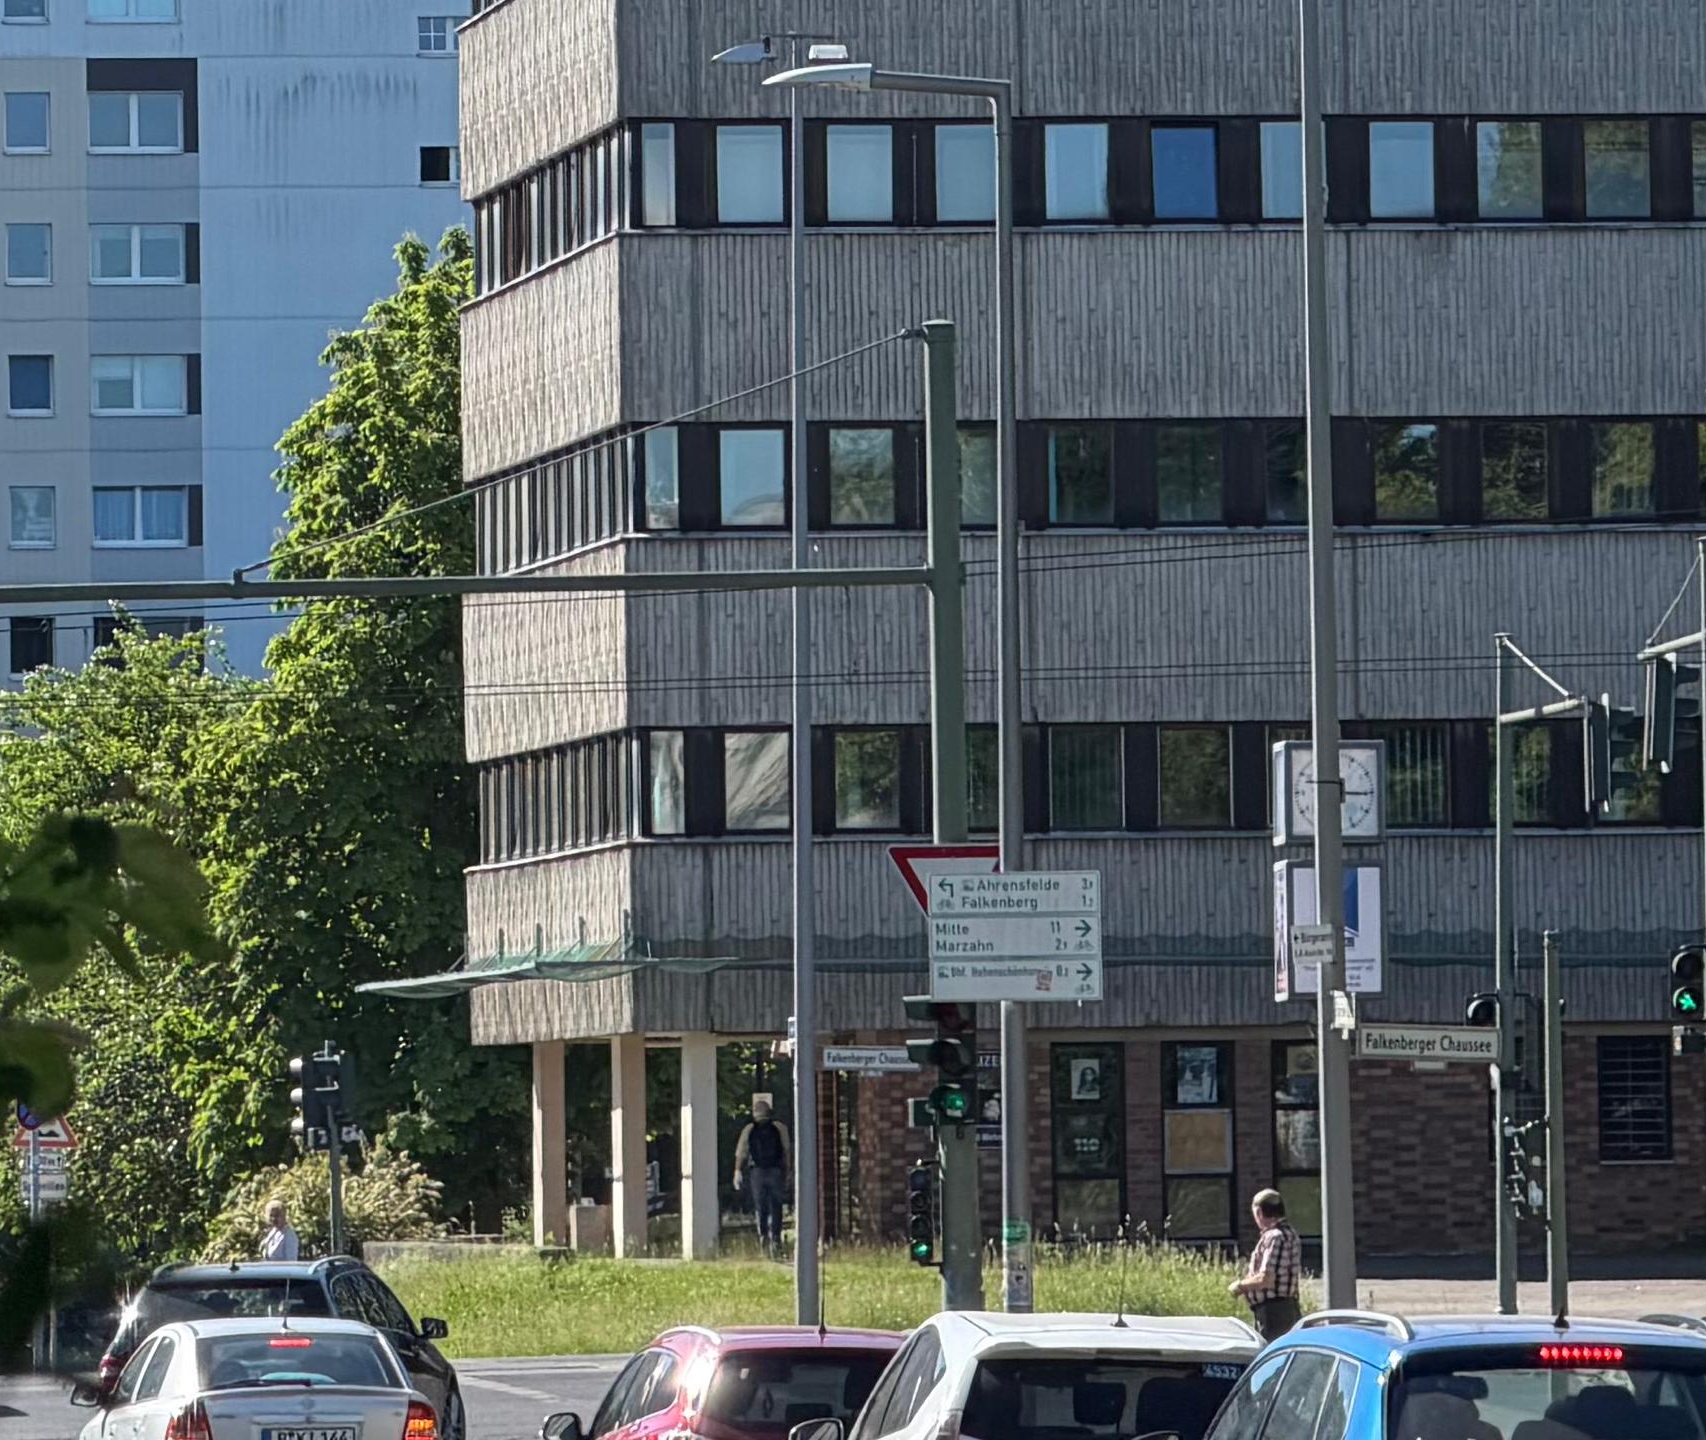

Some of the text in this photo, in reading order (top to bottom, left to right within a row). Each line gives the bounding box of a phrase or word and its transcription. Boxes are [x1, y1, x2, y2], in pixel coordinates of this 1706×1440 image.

[977, 879, 1060, 891] Ahrensfelde
[961, 895, 1038, 911] Falkenberg
[935, 920, 1061, 935] Mitte 11
[935, 939, 994, 952] Marzahn
[1366, 1033, 1492, 1054] Falkenberger Chaussee
[827, 1052, 877, 1065] Falkenberger
